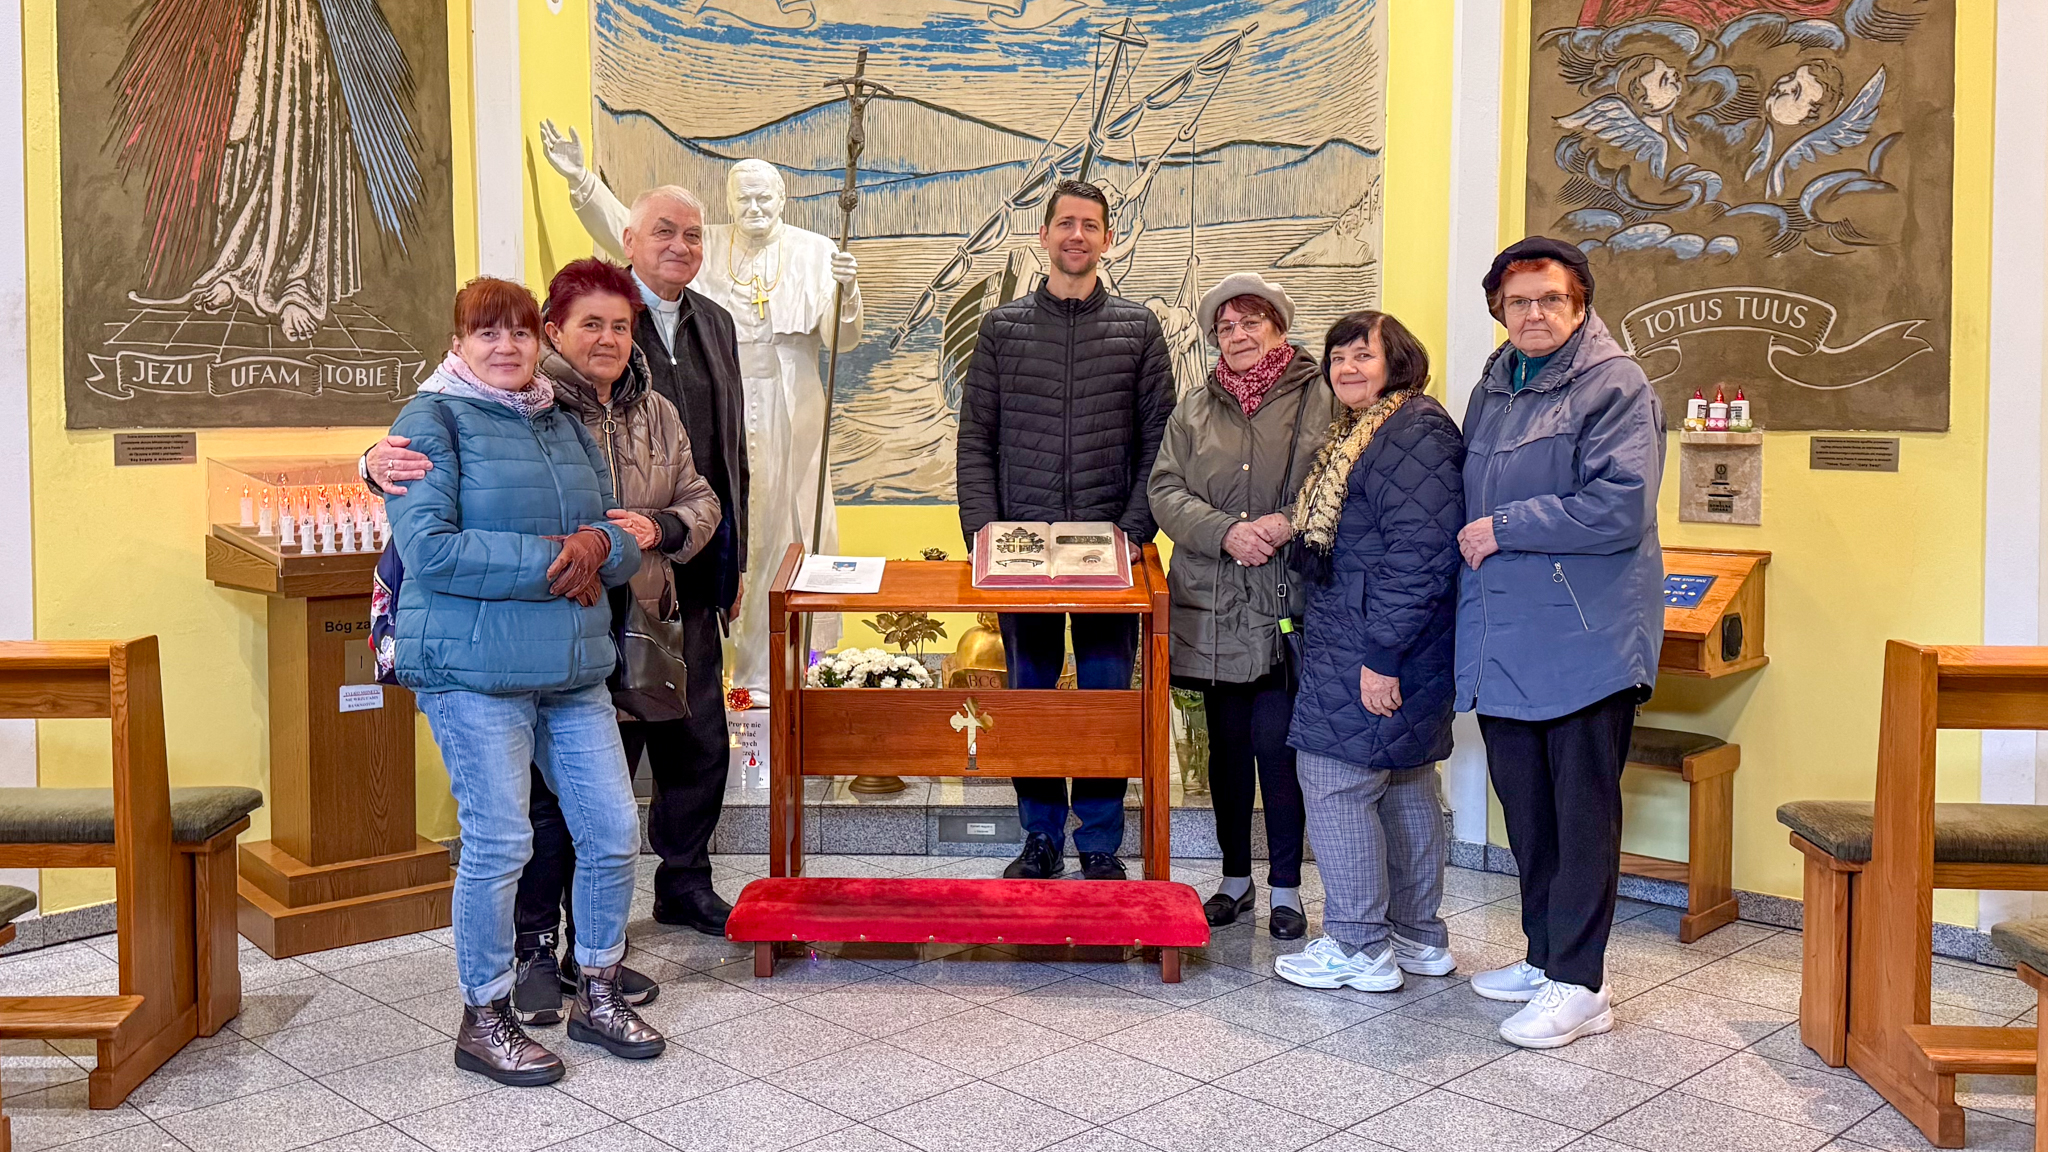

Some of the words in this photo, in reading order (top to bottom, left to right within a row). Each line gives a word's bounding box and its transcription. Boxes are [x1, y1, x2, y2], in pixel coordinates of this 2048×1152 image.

[1639, 298, 1723, 339] TOTUS
[1735, 296, 1809, 329] TUUS
[132, 360, 192, 386] JEZU
[231, 364, 300, 387] UFAM
[323, 363, 388, 387] TOBIE
[325, 620, 352, 634] Bóg
